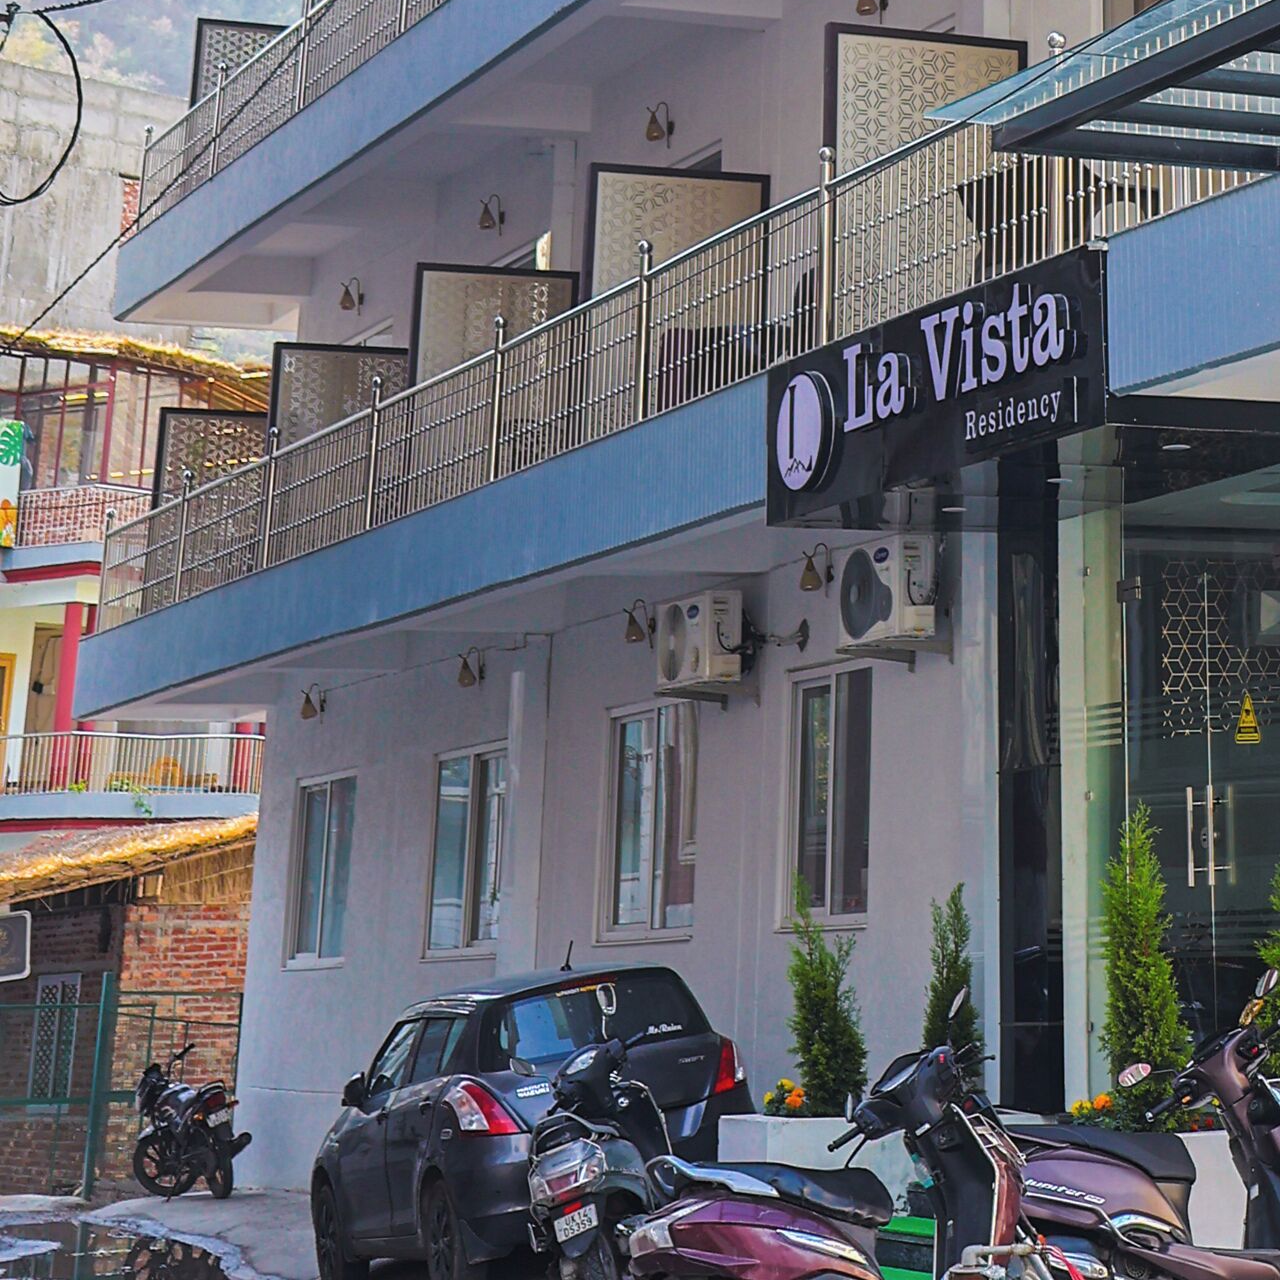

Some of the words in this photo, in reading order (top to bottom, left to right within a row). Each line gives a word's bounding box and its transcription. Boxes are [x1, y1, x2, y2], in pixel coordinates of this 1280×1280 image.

[843, 342, 906, 432] La
[920, 282, 1066, 402] Vista
[965, 390, 1062, 440] Residency
